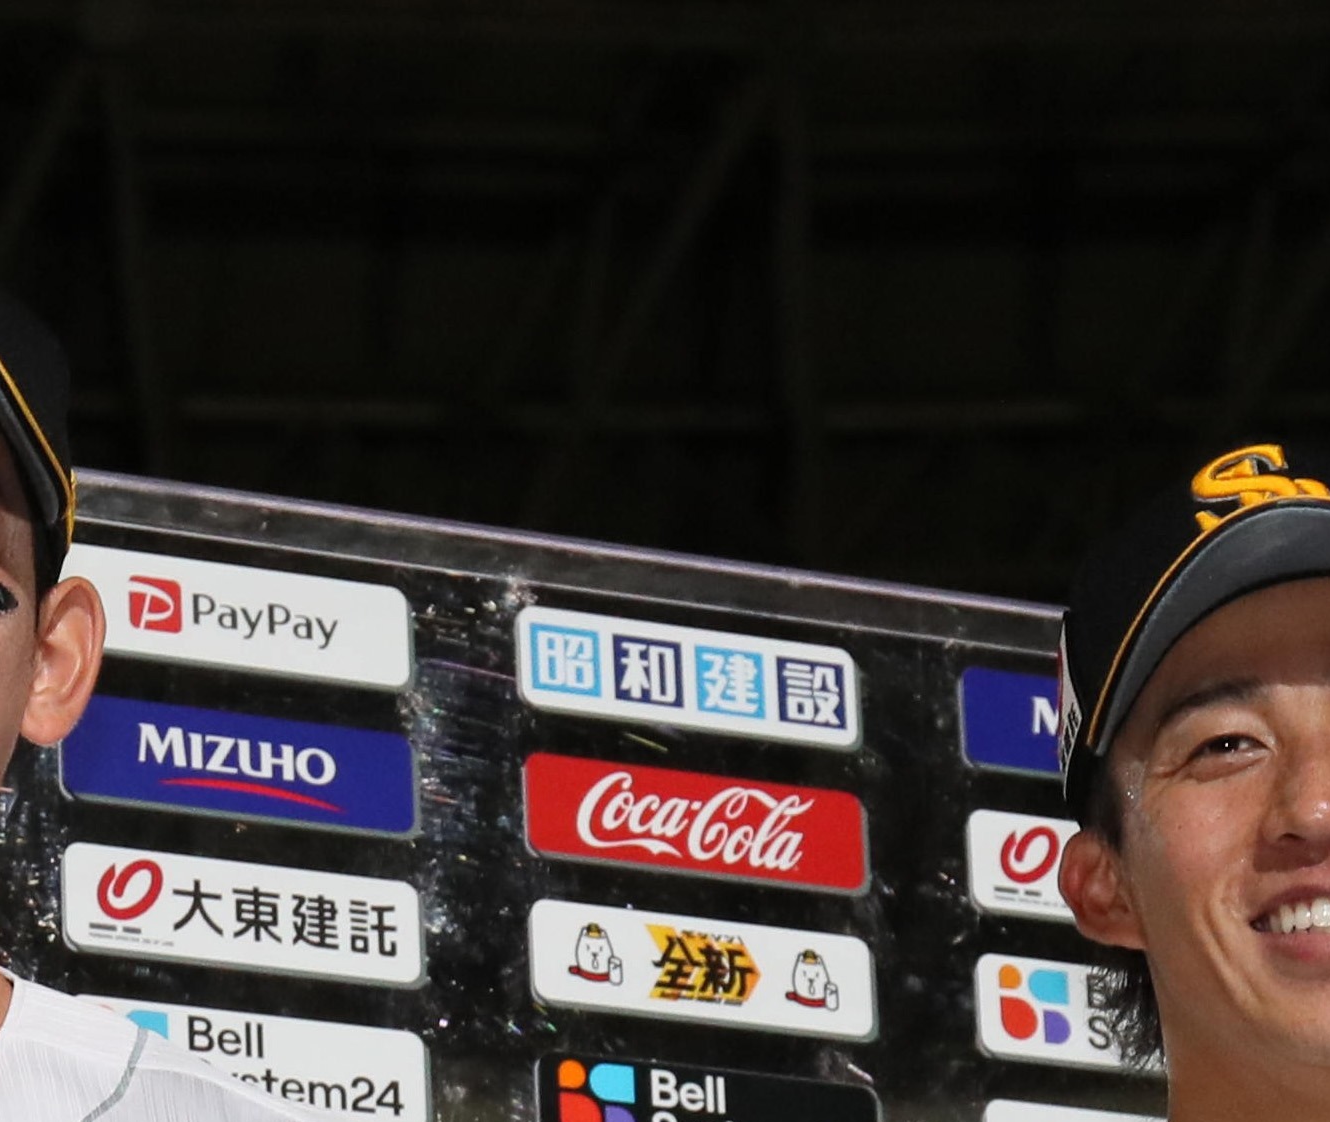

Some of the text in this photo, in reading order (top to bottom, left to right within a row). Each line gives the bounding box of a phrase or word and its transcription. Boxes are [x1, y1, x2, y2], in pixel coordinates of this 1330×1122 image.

[192, 593, 338, 649] PayPay
[536, 630, 841, 727] 昭和建設
[138, 722, 337, 786] MIZUHO
[576, 771, 815, 871] Coca-Cola
[171, 880, 398, 957] 大東建託
[186, 1015, 265, 1059] Bell
[649, 1068, 727, 1115] Bell
